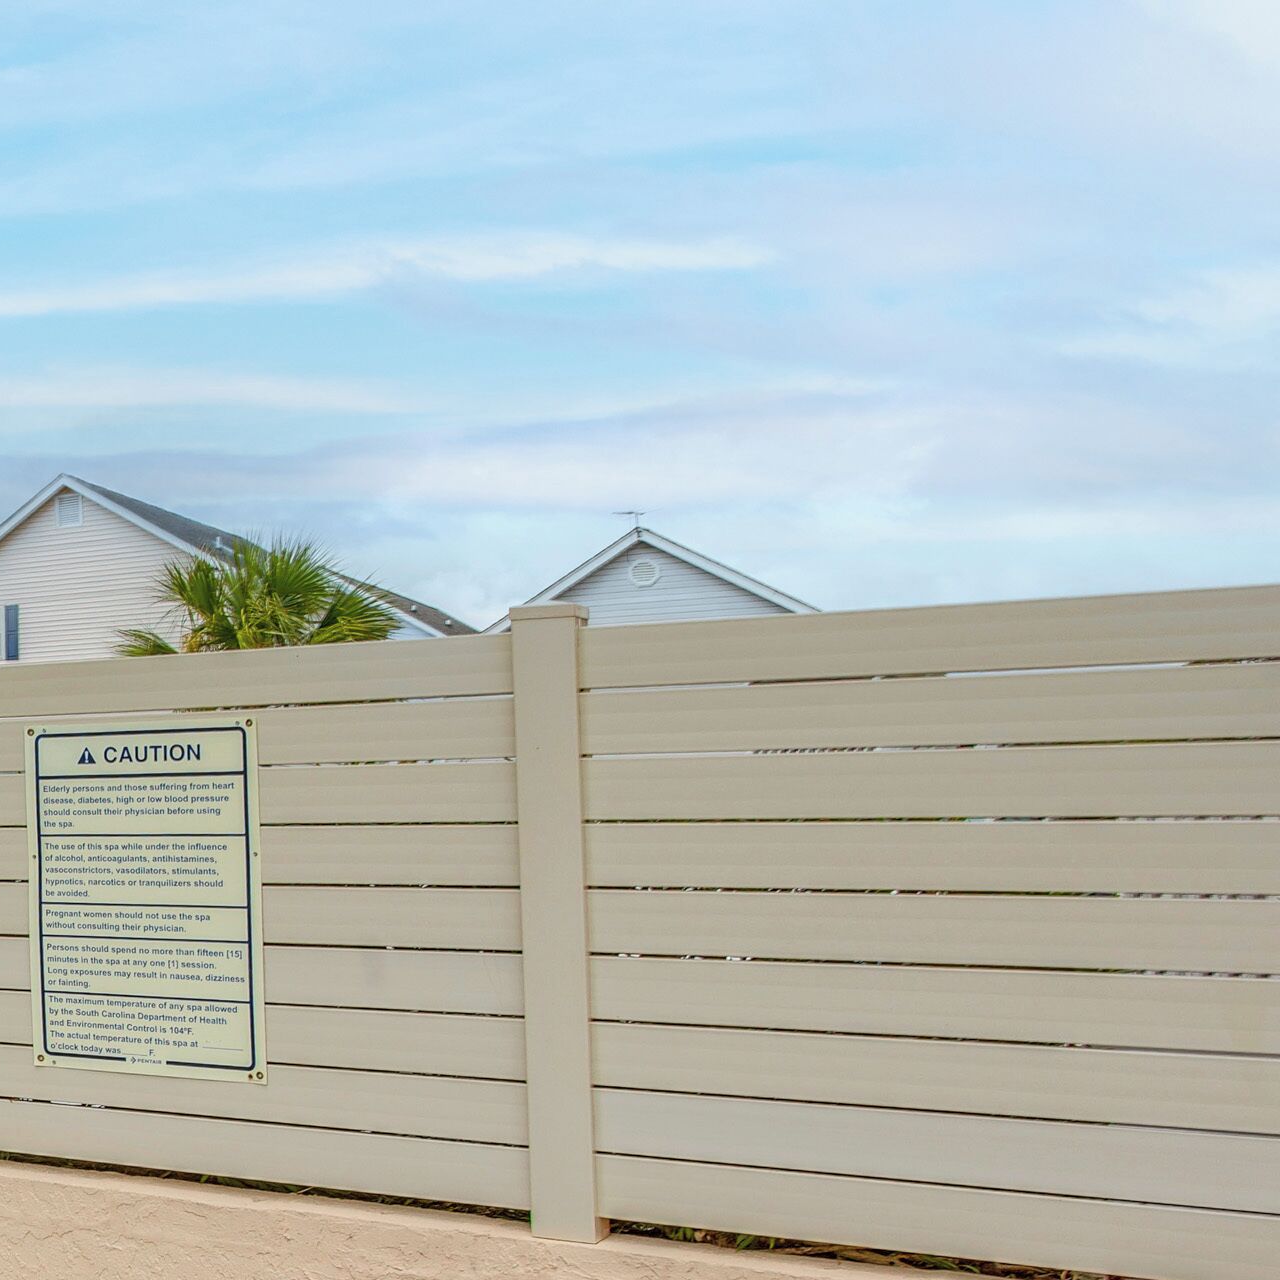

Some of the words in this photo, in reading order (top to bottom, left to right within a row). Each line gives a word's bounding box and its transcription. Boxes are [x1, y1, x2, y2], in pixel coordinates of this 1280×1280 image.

[103, 743, 201, 763] CAUTION
[42, 785, 70, 794] Elderly
[71, 786, 105, 794] persons
[106, 784, 122, 792] and
[123, 784, 147, 792] those
[149, 783, 187, 793] suffering
[189, 782, 210, 790] from
[211, 782, 234, 790] heart
[42, 797, 75, 805] disease,
[77, 796, 113, 805] diabetes,
[115, 796, 134, 805] high
[147, 795, 162, 803] low
[164, 795, 188, 803] blood
[190, 795, 229, 804] pressure
[43, 808, 70, 816] should
[72, 808, 102, 816] consult
[103, 808, 122, 816] their
[124, 807, 165, 817] physician
[166, 807, 194, 815] before
[196, 807, 221, 816] using
[43, 820, 56, 828] the
[58, 821, 74, 829] spa.
[44, 842, 59, 850] The
[76, 842, 86, 850] of
[103, 844, 119, 852] spa
[120, 843, 143, 851] while
[144, 843, 170, 851] under
[171, 843, 185, 851] the
[187, 843, 227, 851] influence
[44, 854, 53, 862] of
[54, 854, 85, 863] alcohol,
[87, 854, 150, 865] anticoagulants,
[151, 855, 217, 864] antihistamines,
[44, 866, 113, 875] vasoconstrictors,
[115, 867, 169, 875] vasodilators,
[171, 867, 219, 876] stimulants,
[45, 877, 86, 887] hypnotics,
[87, 878, 125, 886] narcotics
[138, 879, 191, 889] tranquilizers
[193, 879, 223, 888] should
[45, 889, 55, 897] be
[56, 889, 90, 897] avoided.
[45, 909, 81, 920] Pregnant
[82, 911, 112, 919] women
[114, 911, 143, 920] should
[145, 912, 159, 920] not
[178, 913, 192, 921] the
[194, 914, 210, 923] spa
[45, 921, 75, 929] without
[76, 922, 120, 932] consulting
[121, 923, 141, 931] their
[142, 924, 186, 934] physician.
[46, 943, 79, 952] Persons
[80, 944, 109, 953] should
[110, 946, 136, 956] spend
[151, 948, 173, 956] more
[175, 948, 194, 956] than
[196, 948, 224, 958] fifteen
[226, 950, 242, 960] [15]
[46, 955, 79, 964] minutes
[80, 956, 88, 964] in
[90, 957, 103, 965] the
[105, 958, 120, 967] spa
[122, 958, 130, 966] at
[132, 960, 148, 968] any
[167, 959, 179, 970] [1]
[180, 960, 216, 970] session.
[47, 966, 68, 976] Long
[69, 968, 112, 978] exposures
[113, 971, 131, 980] may
[133, 970, 157, 979] result
[159, 971, 167, 979] in
[169, 973, 203, 982] nausea,
[204, 973, 245, 984] dizziness
[58, 978, 91, 989] fainting.
[48, 995, 63, 1004] The
[65, 996, 104, 1006] maximum
[106, 999, 156, 1011] temperature
[157, 1001, 167, 1010] of
[168, 1003, 184, 1012] any
[186, 1004, 202, 1013] spa
[203, 1004, 237, 1014] allowed
[48, 1007, 59, 1017] by
[60, 1008, 73, 1016] the
[75, 1008, 99, 1017] South
[101, 1009, 135, 1020] Carolina
[137, 1012, 186, 1024] Department
[188, 1015, 197, 1024] of
[198, 1016, 227, 1026] Health
[49, 1018, 64, 1027] and
[66, 1019, 124, 1031] Environmental
[126, 1023, 157, 1033] Control
[159, 1025, 167, 1034] is
[49, 1030, 65, 1039] The
[66, 1031, 91, 1040] actual
[92, 1033, 142, 1045] temperature
[143, 1036, 152, 1045] of
[154, 1037, 170, 1046] this
[172, 1040, 188, 1049] spa
[189, 1040, 198, 1048] at
[50, 1041, 78, 1051] o'clock
[80, 1044, 103, 1055] today
